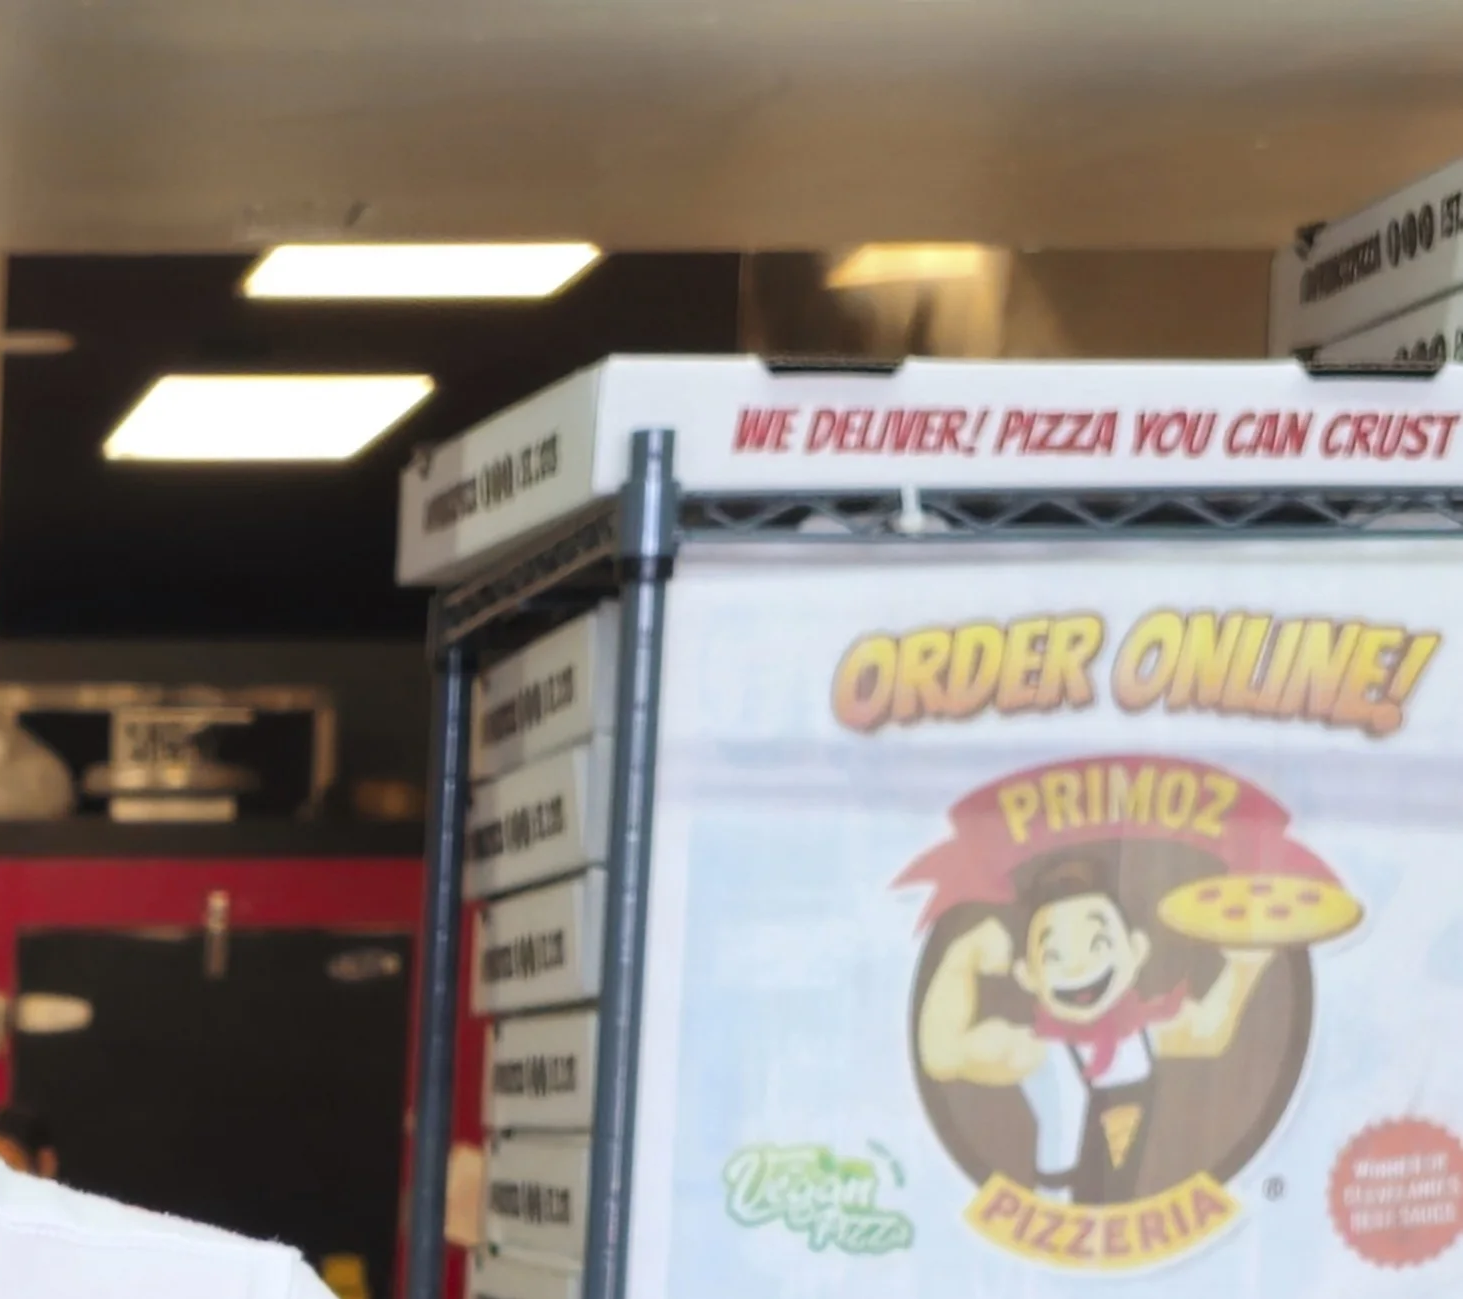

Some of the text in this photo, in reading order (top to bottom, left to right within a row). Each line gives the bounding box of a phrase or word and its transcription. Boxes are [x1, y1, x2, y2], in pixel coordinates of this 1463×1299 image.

[732, 406, 1462, 461] WE DELIVER! PIZZA YOU CAN CRUST
[832, 608, 1442, 741] ORDER ONLINE!
[996, 762, 1240, 844] PRIMOZ
[979, 1180, 1232, 1260] PIZZERIA
